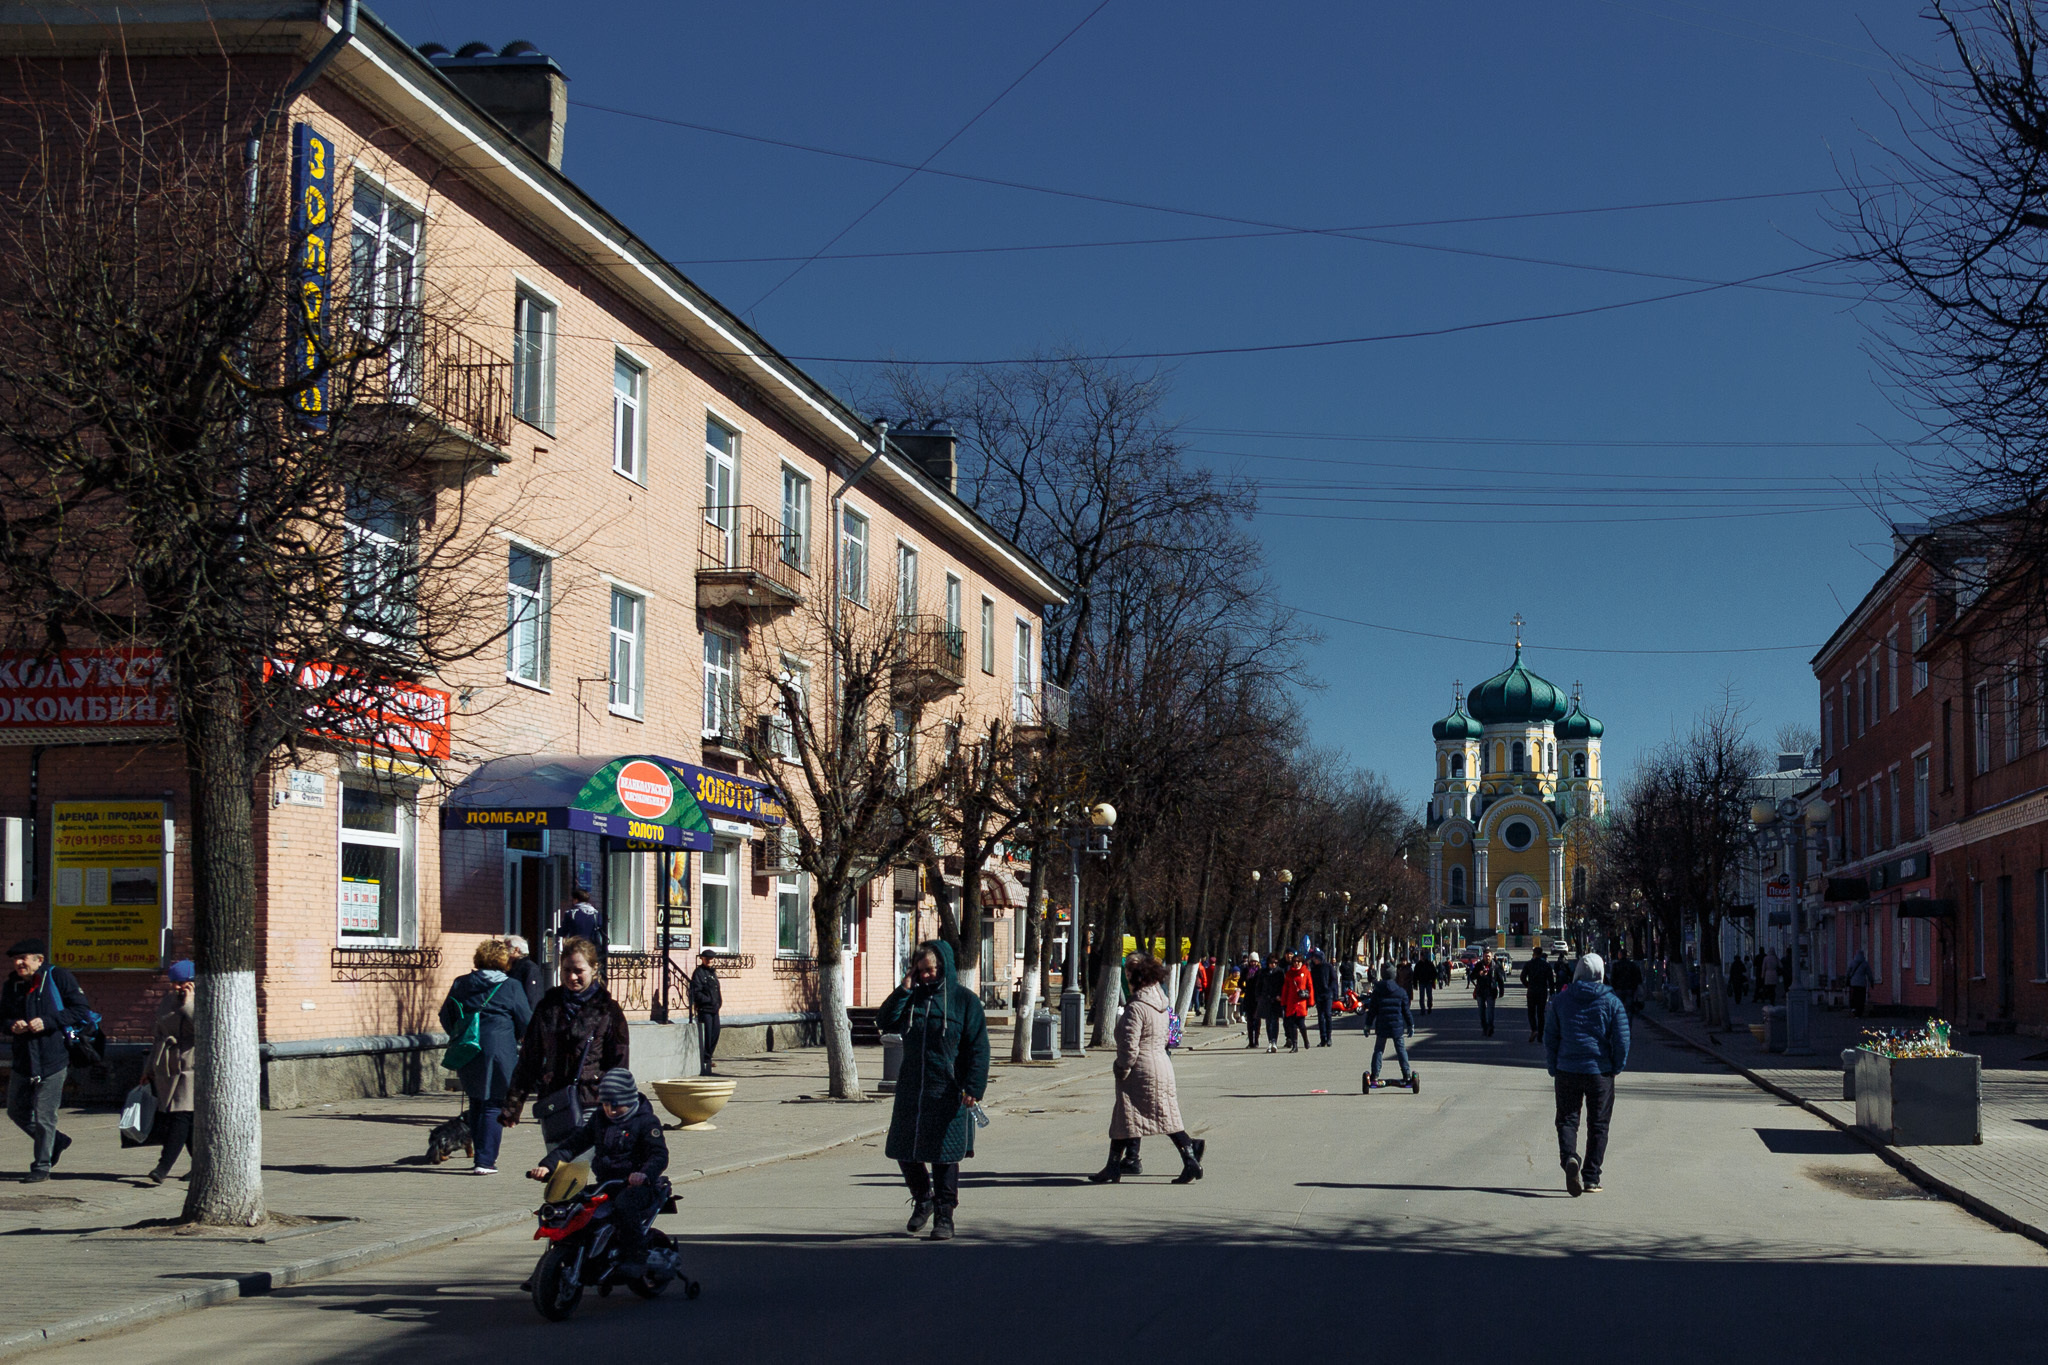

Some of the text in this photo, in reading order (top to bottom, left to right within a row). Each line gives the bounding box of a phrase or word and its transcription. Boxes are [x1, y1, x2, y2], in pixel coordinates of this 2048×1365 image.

[696, 772, 754, 812] ЗОЛОТО
[57, 812, 99, 823] АРЕНДА
[107, 811, 160, 822] ПРОДАЖА
[465, 811, 549, 826] ЛОМБАРД
[628, 820, 664, 841] ЗОЛОТО
[66, 938, 149, 947] АРЕНДА ДОЛГОСРОЧНАЯ
